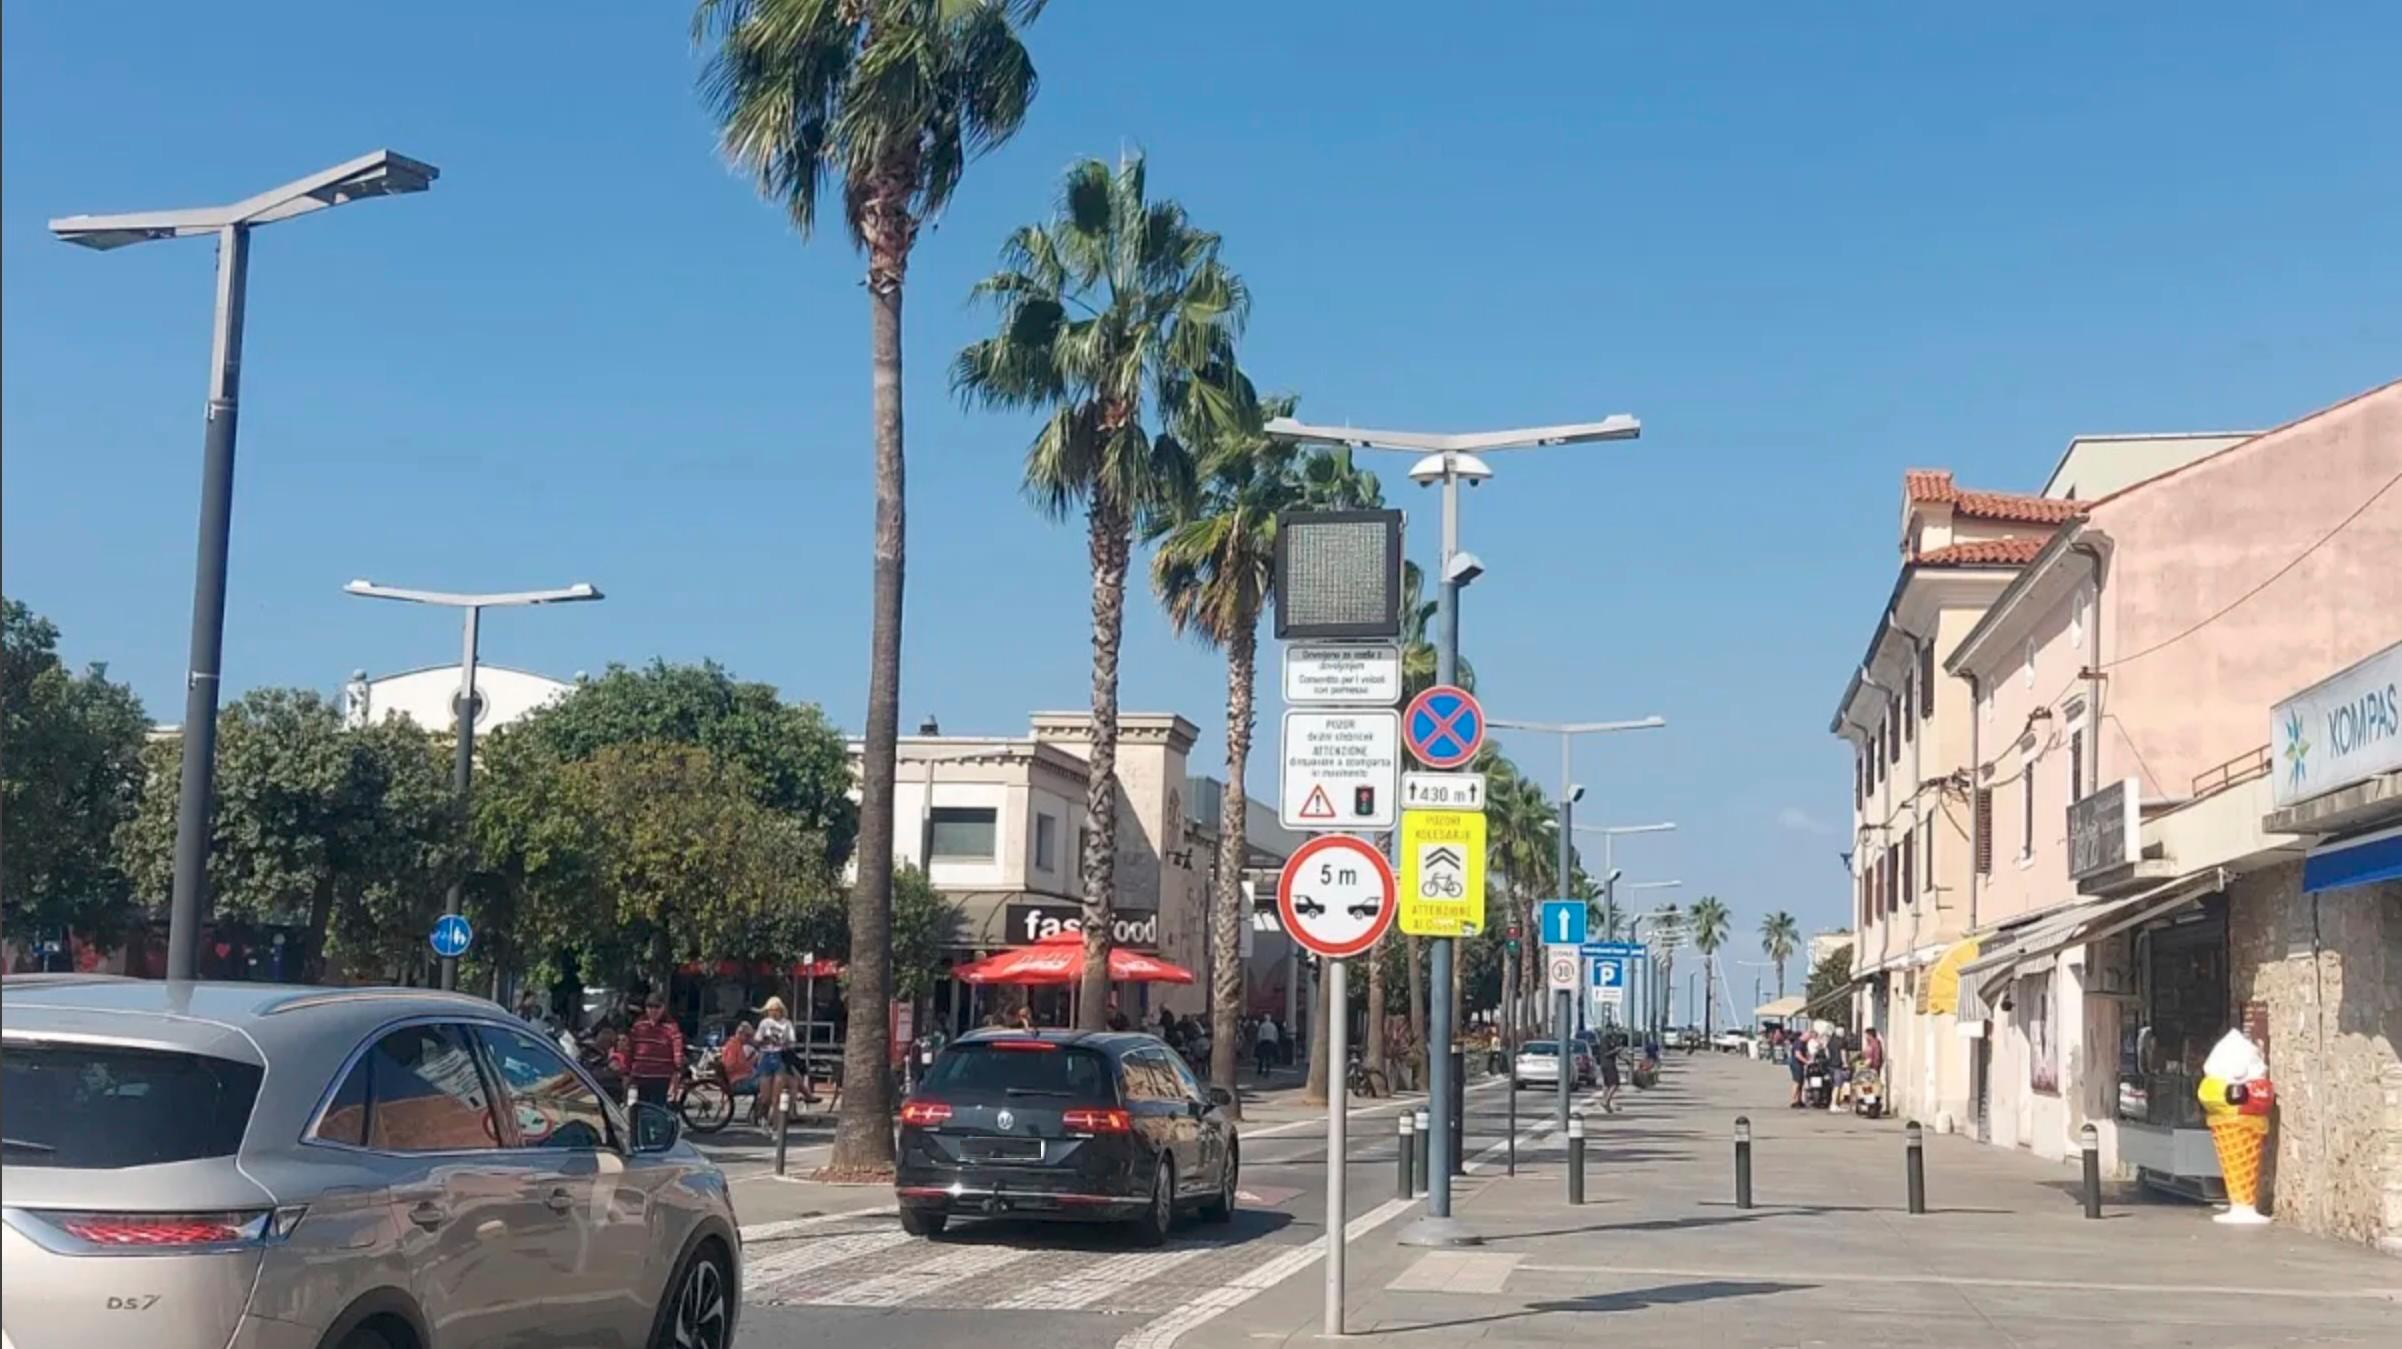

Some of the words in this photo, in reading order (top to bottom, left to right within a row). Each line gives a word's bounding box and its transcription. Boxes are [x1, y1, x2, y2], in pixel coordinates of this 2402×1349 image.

[1342, 676, 1353, 685] per
[1325, 719, 1356, 729] POZOR
[2328, 683, 2398, 759] KOMPAS
[1312, 745, 1367, 756] ATTENZIONE
[1420, 786, 1449, 802] 430
[1453, 790, 1466, 802] m
[1321, 864, 1332, 885] 5
[1339, 869, 1357, 885] m
[1024, 909, 1082, 940] fas
[1600, 965, 1615, 985] P
